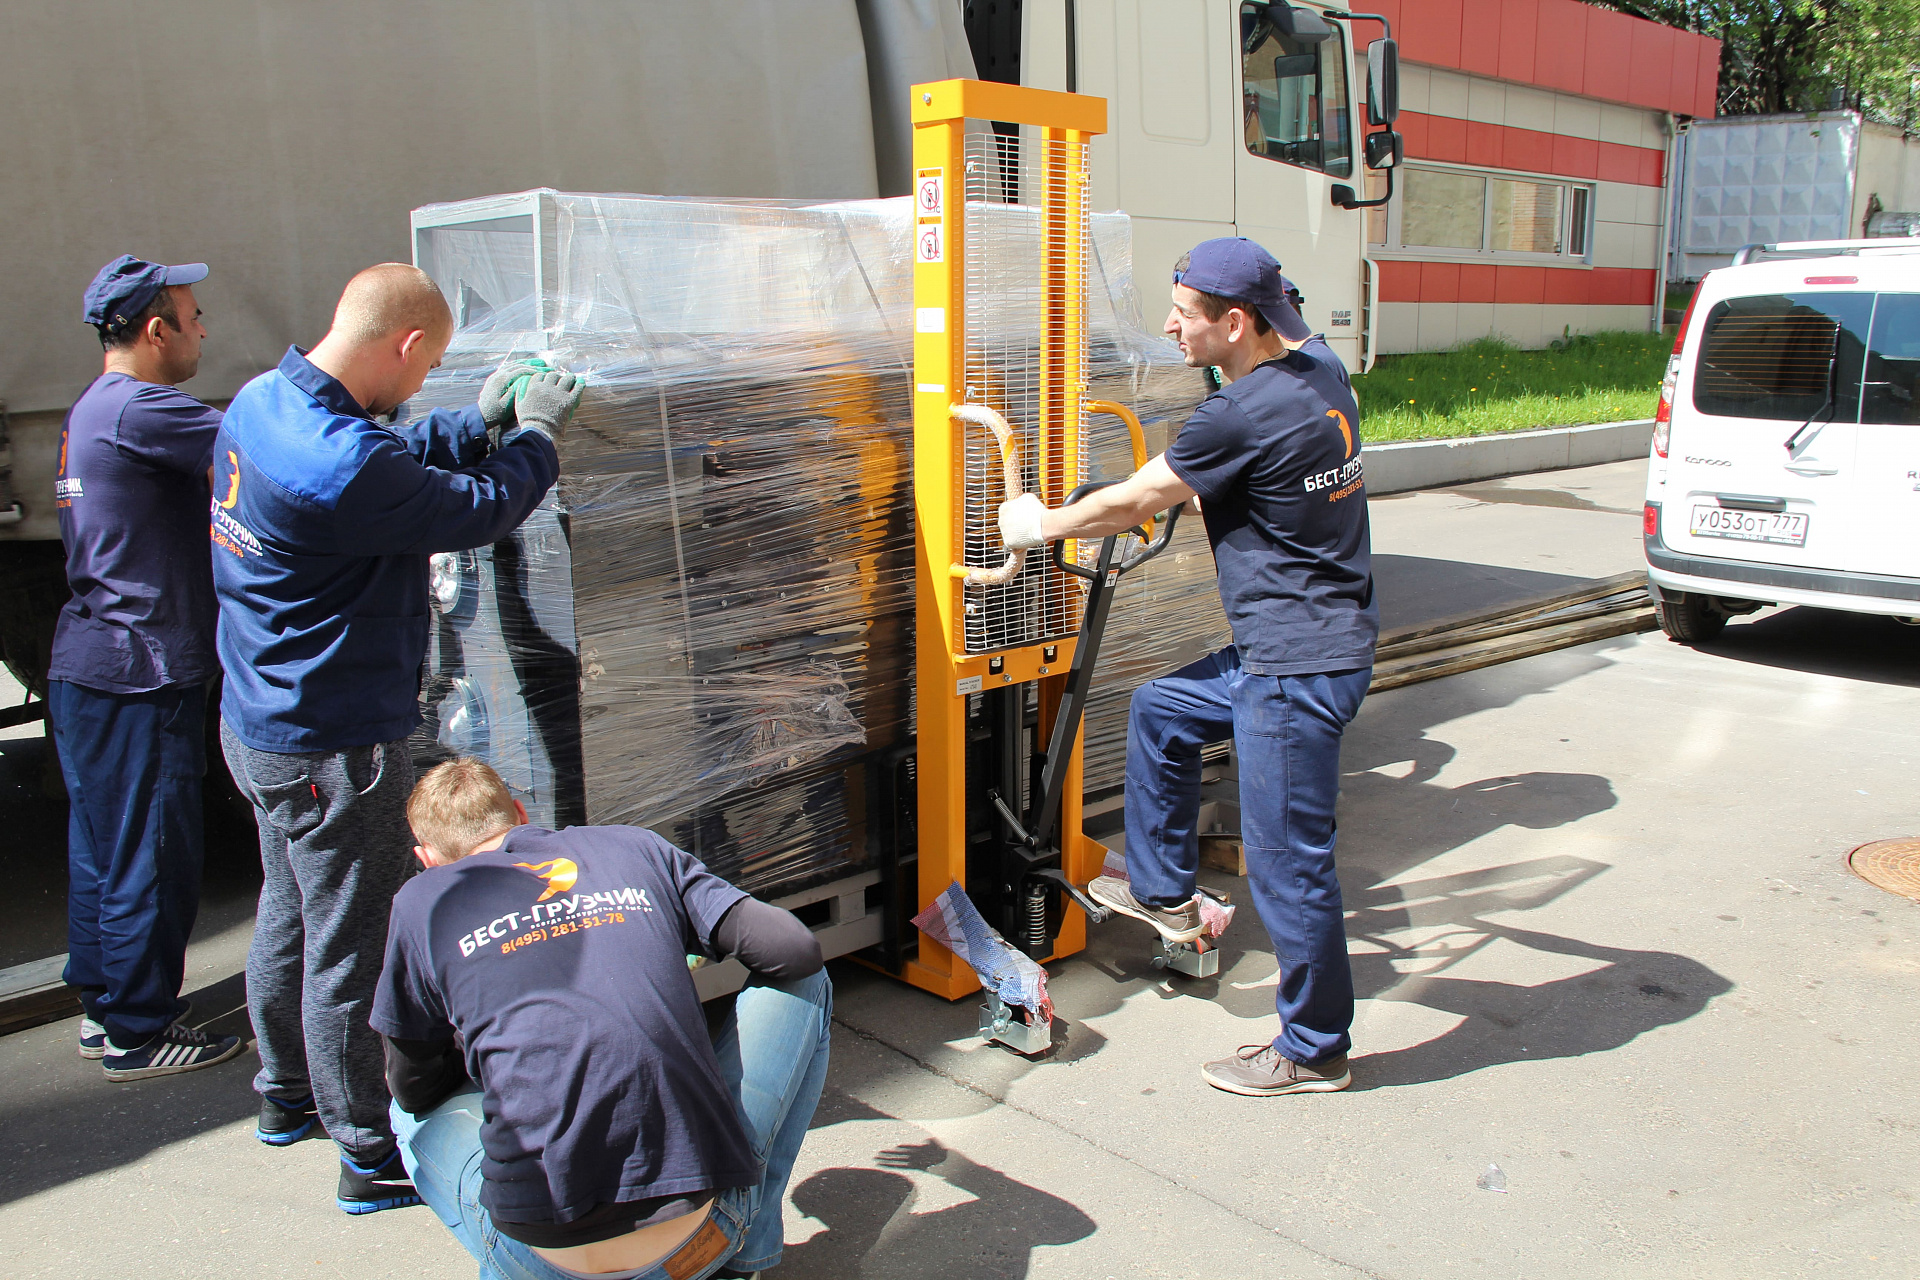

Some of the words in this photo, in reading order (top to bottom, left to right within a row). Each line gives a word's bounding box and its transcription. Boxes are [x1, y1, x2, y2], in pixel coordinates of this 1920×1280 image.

[1331, 310, 1351, 318] DAF
[1773, 515, 1800, 530] 777
[458, 887, 651, 958] БЕСТ-ГРУЗЧИК
[501, 928, 548, 955] 8(495)
[550, 912, 625, 938] 281-51-78
